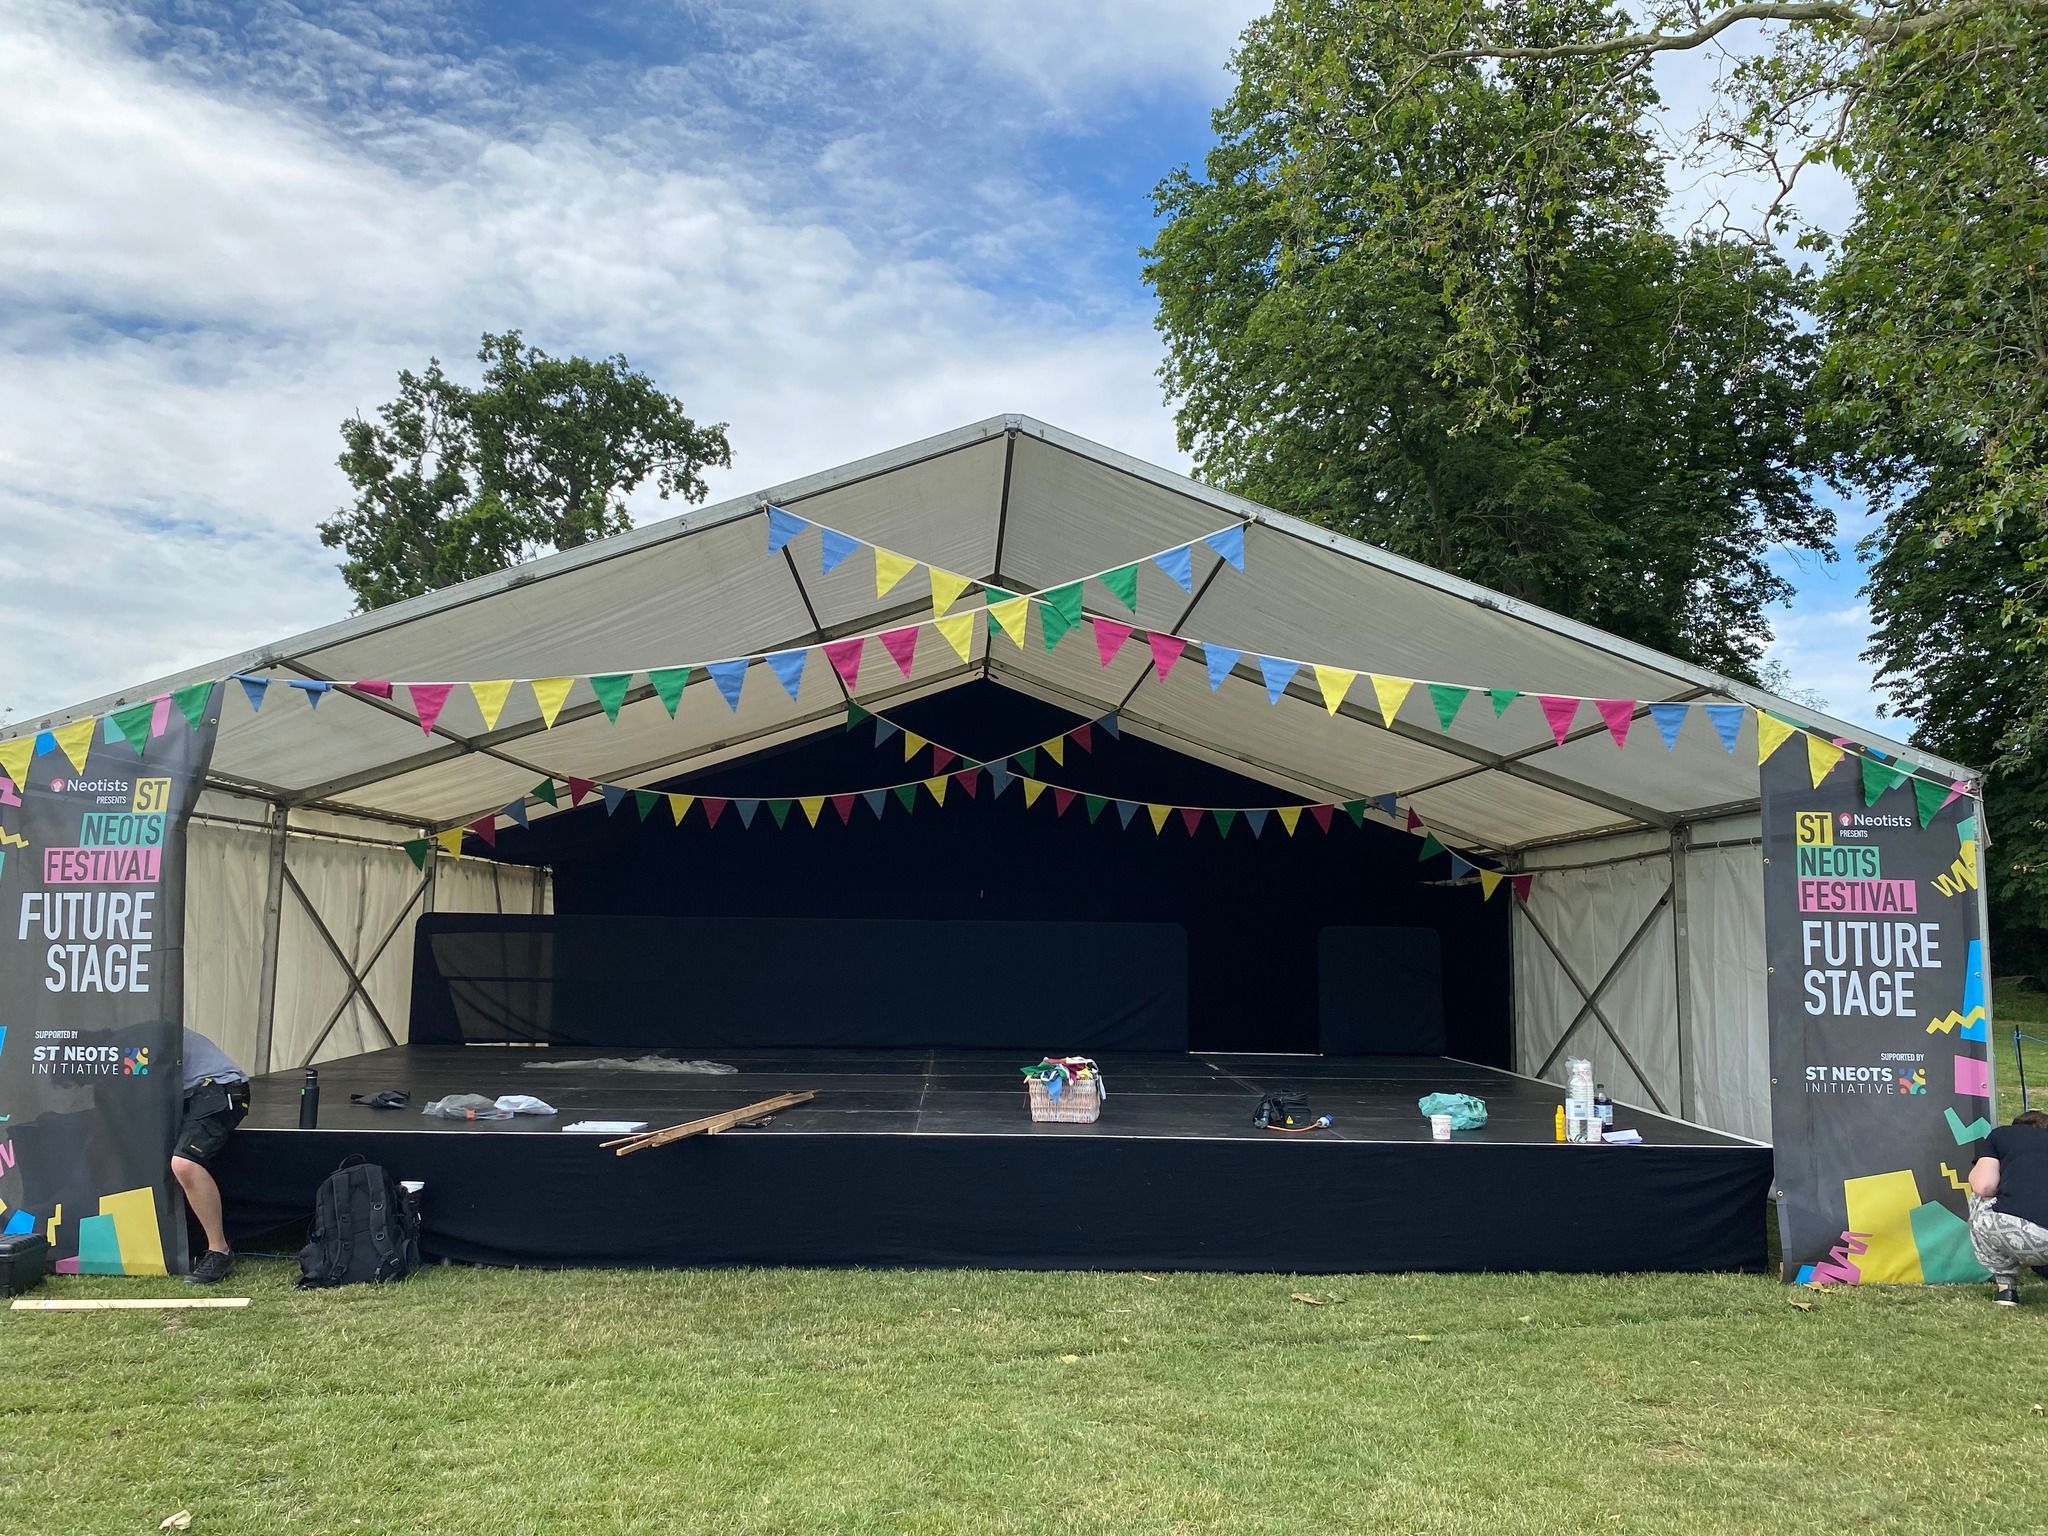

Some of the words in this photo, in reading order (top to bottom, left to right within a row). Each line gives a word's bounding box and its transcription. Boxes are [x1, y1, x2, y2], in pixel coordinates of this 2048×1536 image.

[67, 779, 128, 792] Neotists
[137, 781, 167, 810] ST
[96, 796, 127, 804] PRESENTS
[84, 815, 162, 845] NEOTS
[1800, 814, 1828, 843] ST
[1854, 814, 1912, 827] Neotists
[1840, 829, 1868, 838] PRESENTS
[47, 850, 156, 881] FESTIVAL
[1800, 847, 1877, 877] NEOTS
[1801, 881, 1913, 912] FESTIVAL
[18, 891, 155, 940] FUTURE
[1802, 920, 1942, 968] FUTURE
[45, 944, 152, 992] STAGE
[1803, 969, 1917, 1017] STAGE
[35, 1030, 71, 1039] SUPPORTED
[71, 1030, 78, 1039] BY
[33, 1046, 60, 1061] ST
[64, 1046, 119, 1061] NEOTS
[1880, 1053, 1915, 1061] SUPPORTED
[1916, 1053, 1924, 1061] BY
[31, 1063, 119, 1075] INITIATIVE
[1805, 1066, 1828, 1080] ST
[1832, 1066, 1893, 1082] NEOTS
[1805, 1082, 1894, 1095] INITIATIVE
